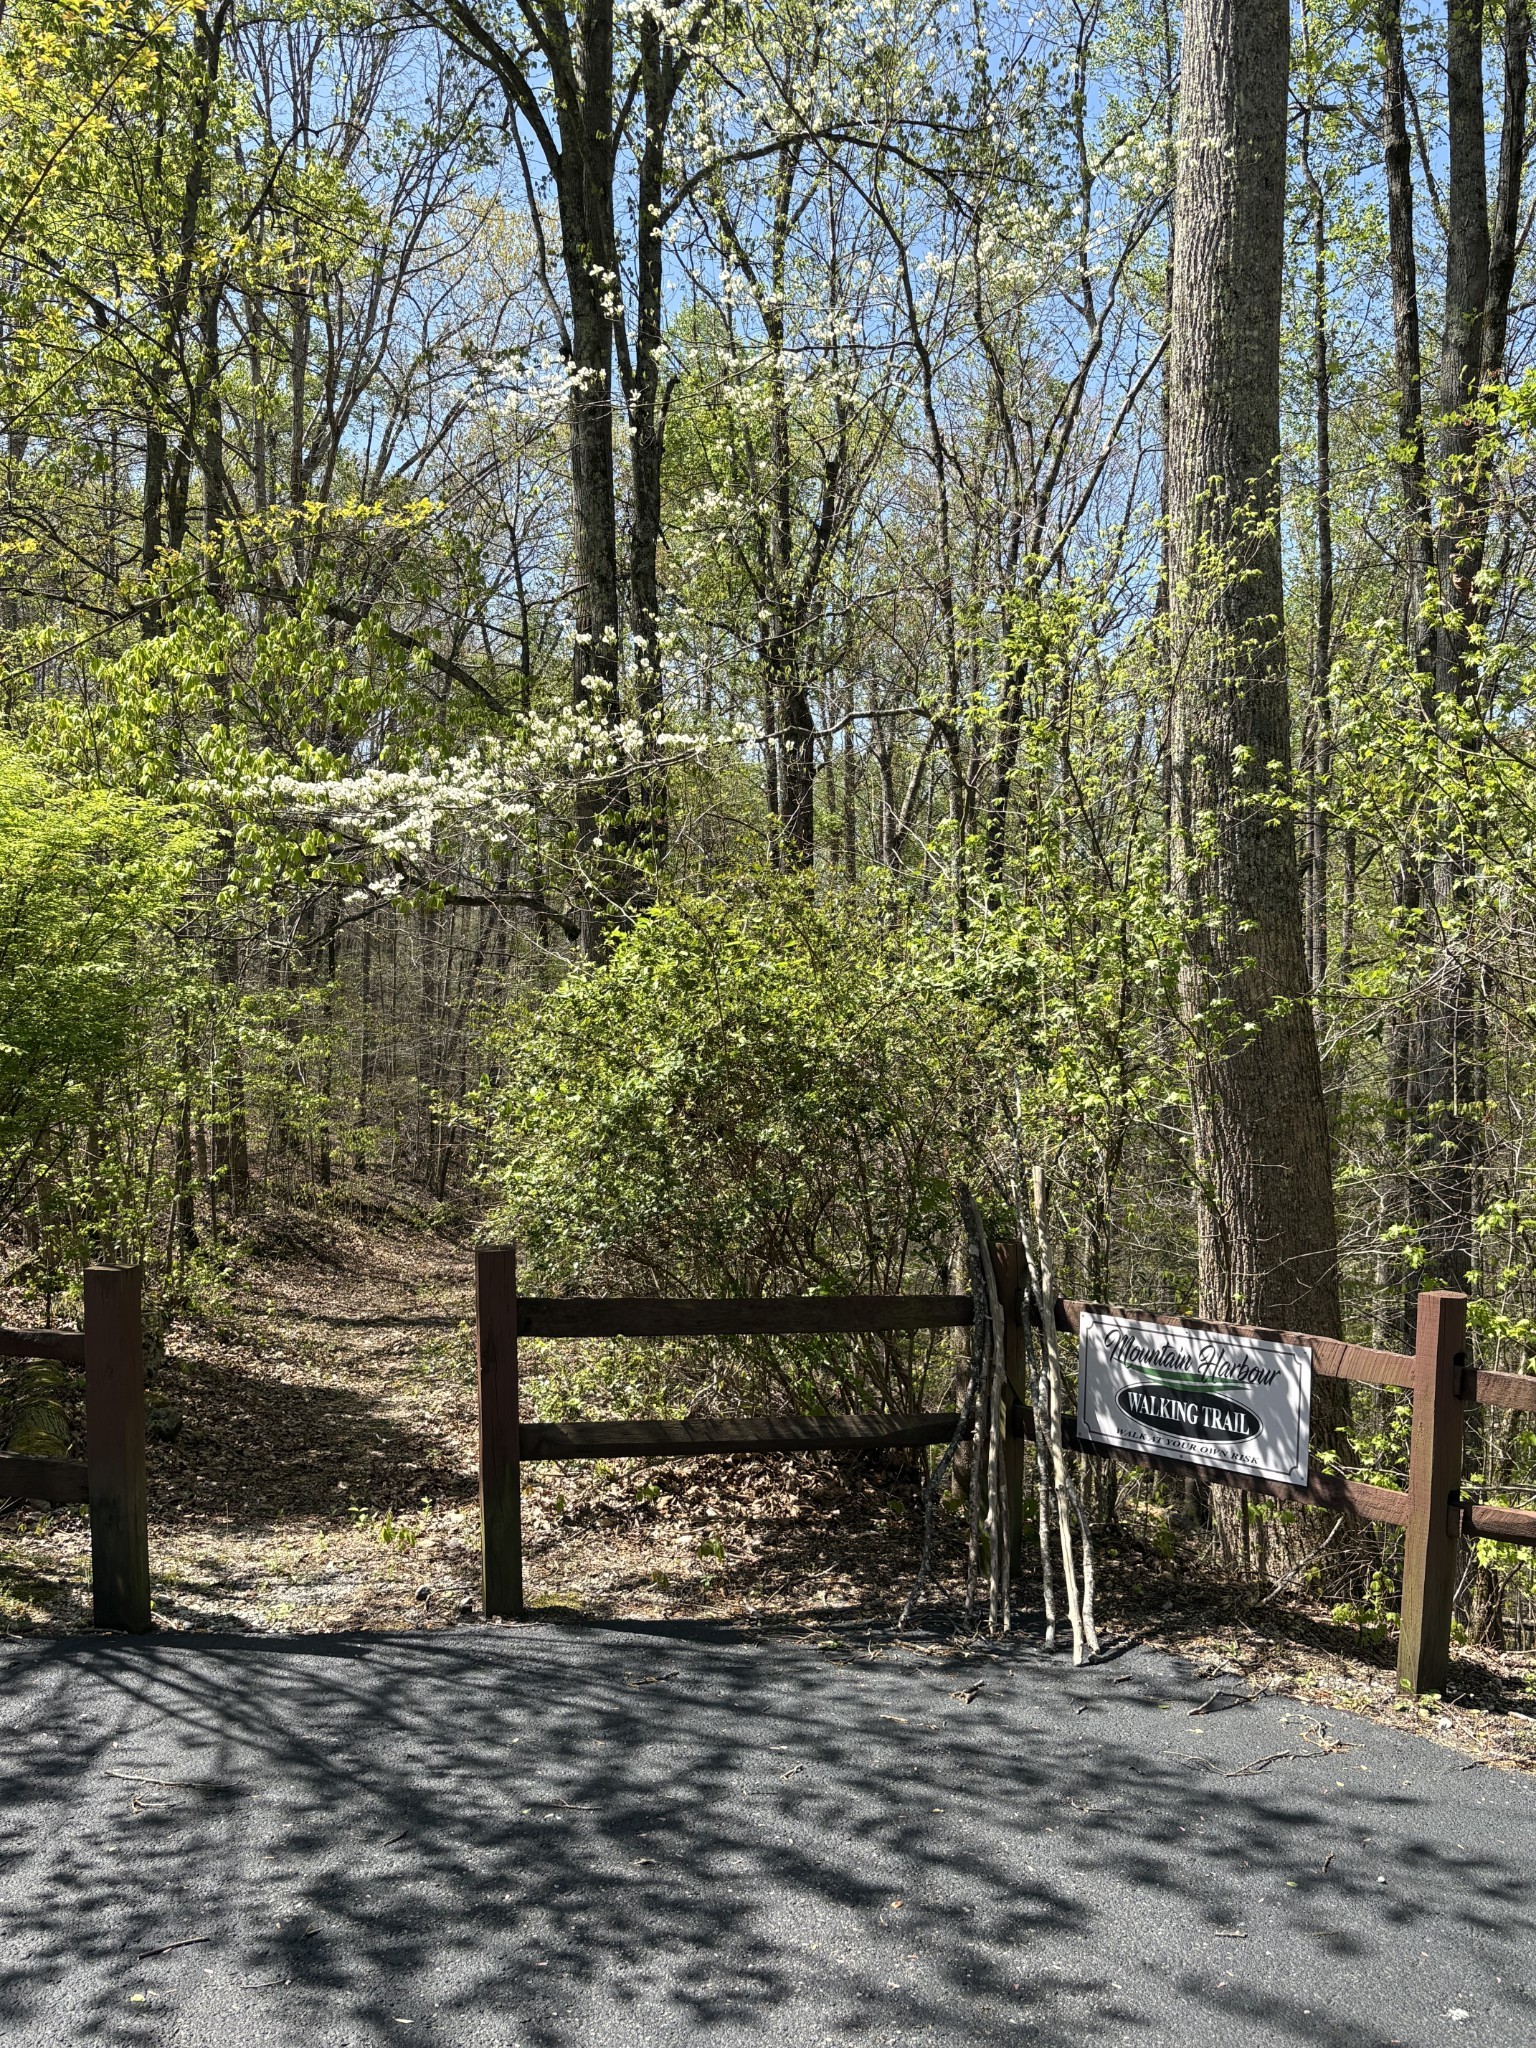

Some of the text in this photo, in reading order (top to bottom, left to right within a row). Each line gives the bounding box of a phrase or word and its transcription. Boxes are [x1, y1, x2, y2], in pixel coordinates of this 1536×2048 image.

[1104, 1329, 1281, 1386] Mountain Harbour
[1127, 1391, 1250, 1435] WALKING TRAIL
[1116, 1428, 1259, 1465] WALK AT YOUR OWN RISK
